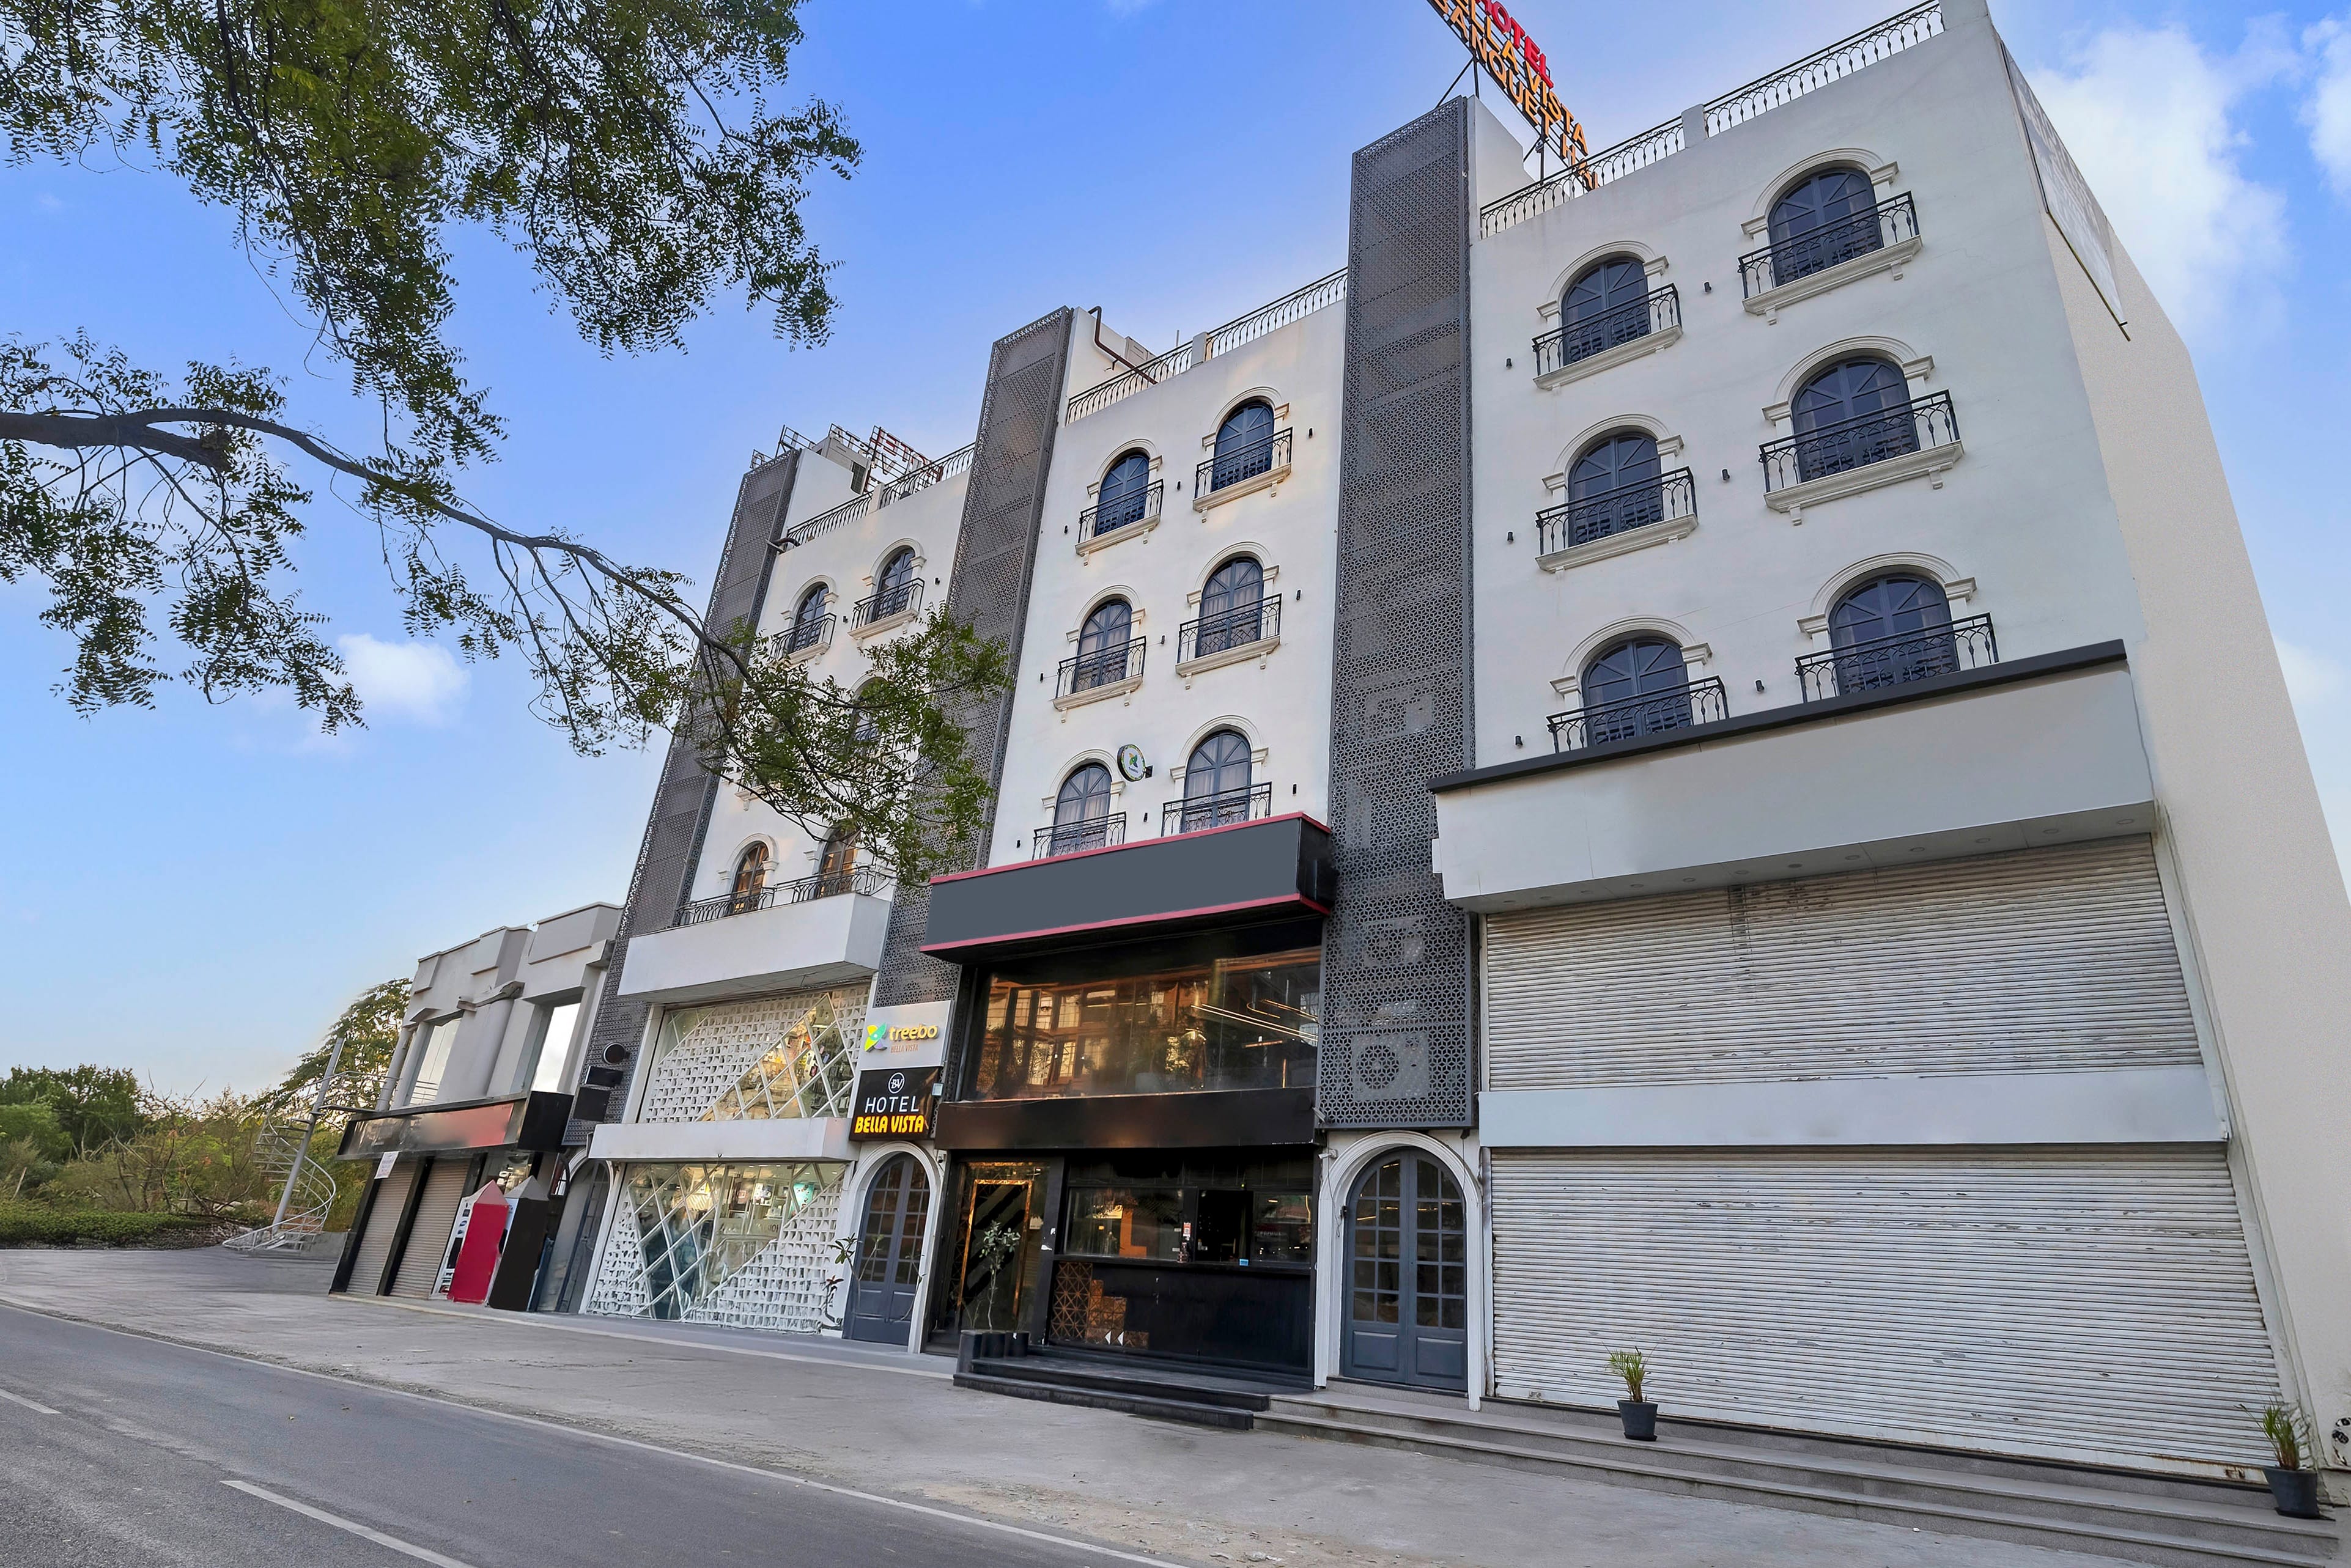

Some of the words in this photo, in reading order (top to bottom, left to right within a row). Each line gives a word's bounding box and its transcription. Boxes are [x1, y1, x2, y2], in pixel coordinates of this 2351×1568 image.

[1524, 61, 1589, 156] VISTA
[888, 1023, 938, 1041] treebo
[865, 1095, 919, 1113] HOTEL
[854, 1115, 888, 1133] BELLA
[891, 1115, 925, 1133] VISTA
